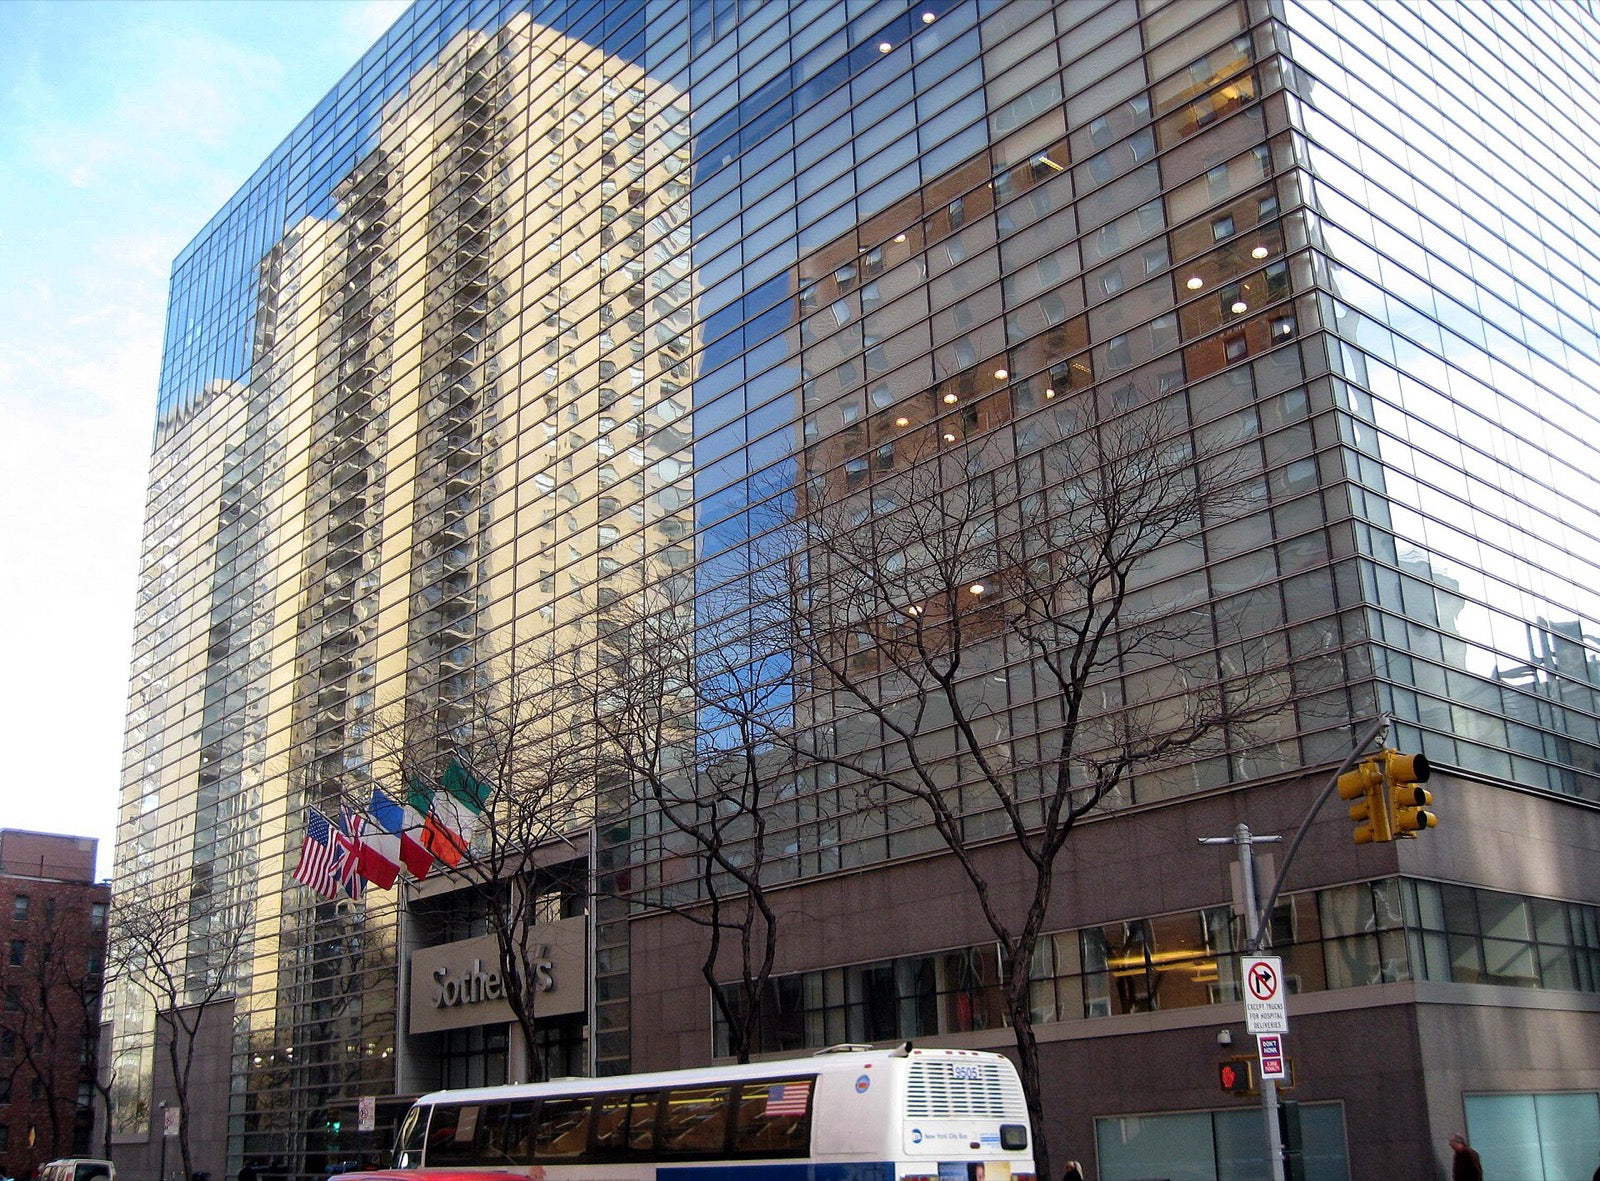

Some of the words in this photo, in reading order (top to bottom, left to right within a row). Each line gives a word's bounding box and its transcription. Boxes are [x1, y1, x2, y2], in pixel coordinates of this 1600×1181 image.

[432, 944, 553, 1009] Sothe's
[1247, 1003, 1265, 1011] EXCEPT
[1250, 1012, 1259, 1020] FOR
[1260, 1012, 1283, 1020] HOSPITAL
[1253, 1021, 1282, 1029] DELIVERIES
[1262, 1040, 1277, 1048] DON'T
[955, 1066, 977, 1079] 9505
